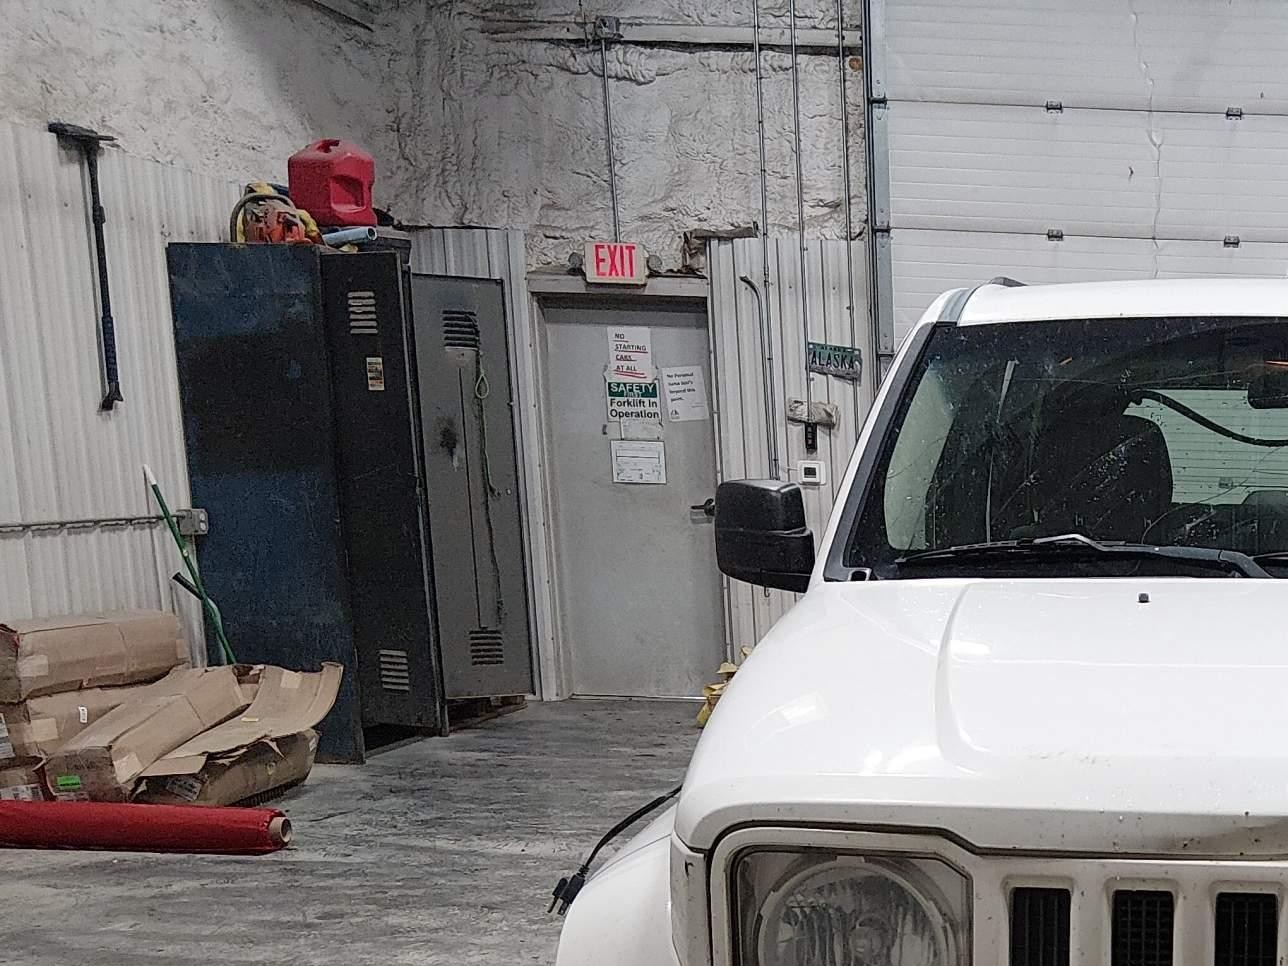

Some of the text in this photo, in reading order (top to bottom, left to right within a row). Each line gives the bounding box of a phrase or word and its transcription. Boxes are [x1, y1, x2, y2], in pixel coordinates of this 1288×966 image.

[595, 245, 635, 277] EXIT
[810, 350, 854, 370] ALASKA
[610, 383, 655, 393] SAFETY
[610, 399, 658, 408] Forklift In
[610, 409, 660, 420] Operation
